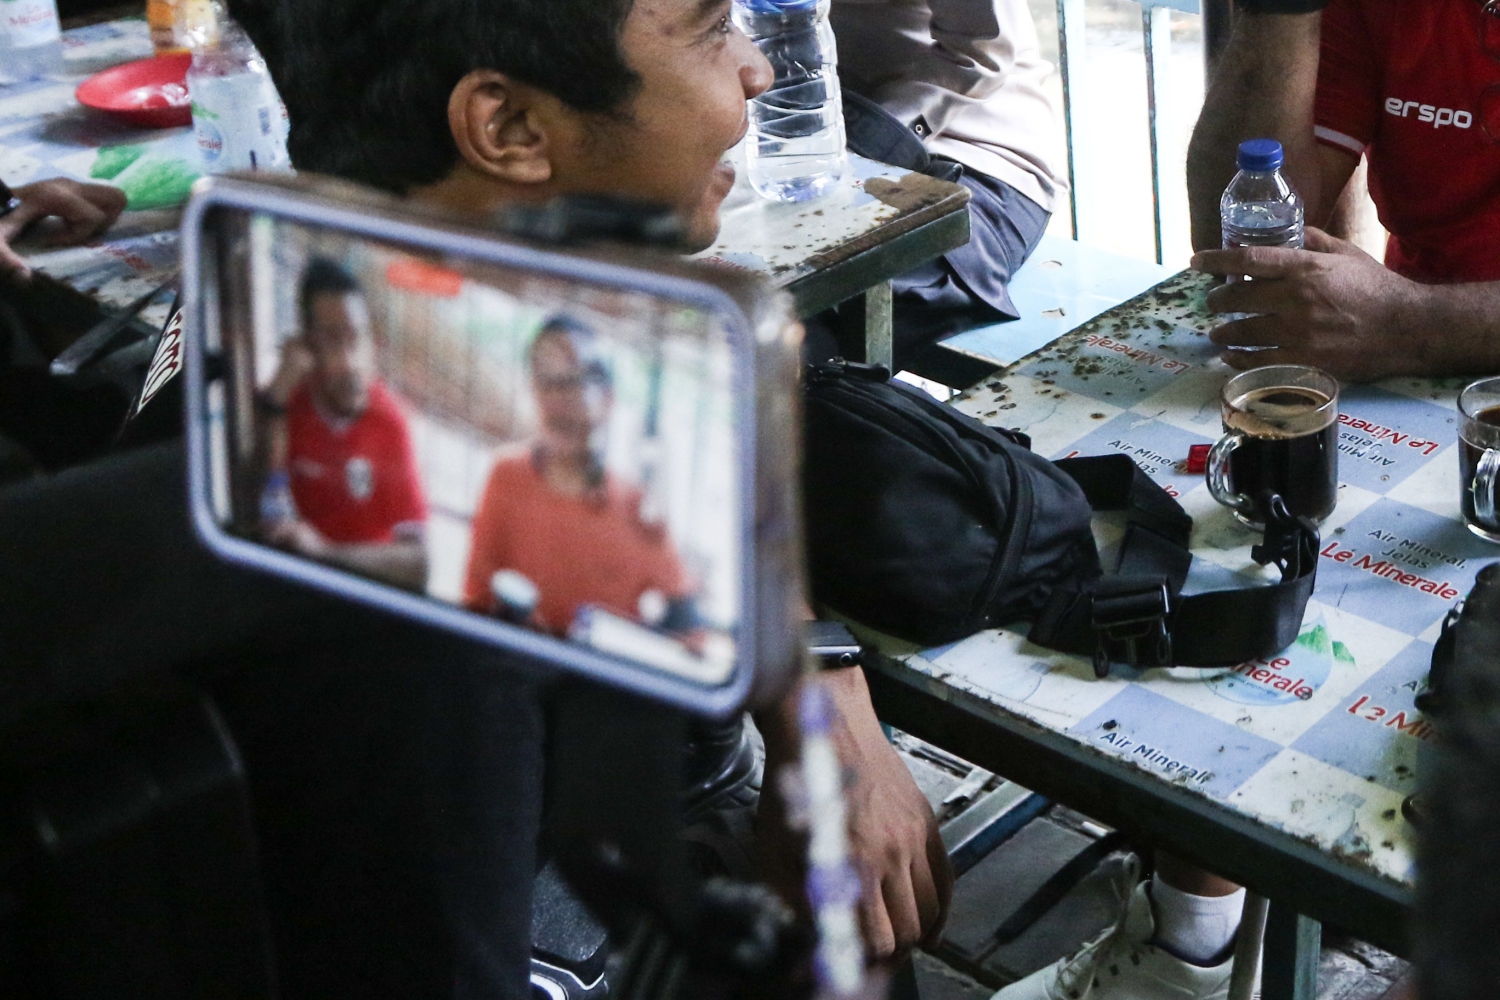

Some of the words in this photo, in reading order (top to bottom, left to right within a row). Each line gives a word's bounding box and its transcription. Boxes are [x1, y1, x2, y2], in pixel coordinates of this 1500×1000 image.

[1385, 97, 1472, 129] erspo
[1163, 360, 1191, 375] Le
[1108, 440, 1133, 451] Air
[1340, 432, 1383, 450] Jelas
[1408, 440, 1439, 455] Le
[1367, 454, 1396, 466] Air
[1368, 529, 1397, 542] Air
[1381, 548, 1431, 569] Jelas
[1320, 542, 1353, 563] Le
[1353, 554, 1459, 600] Minerale
[1100, 732, 1133, 748] Air
